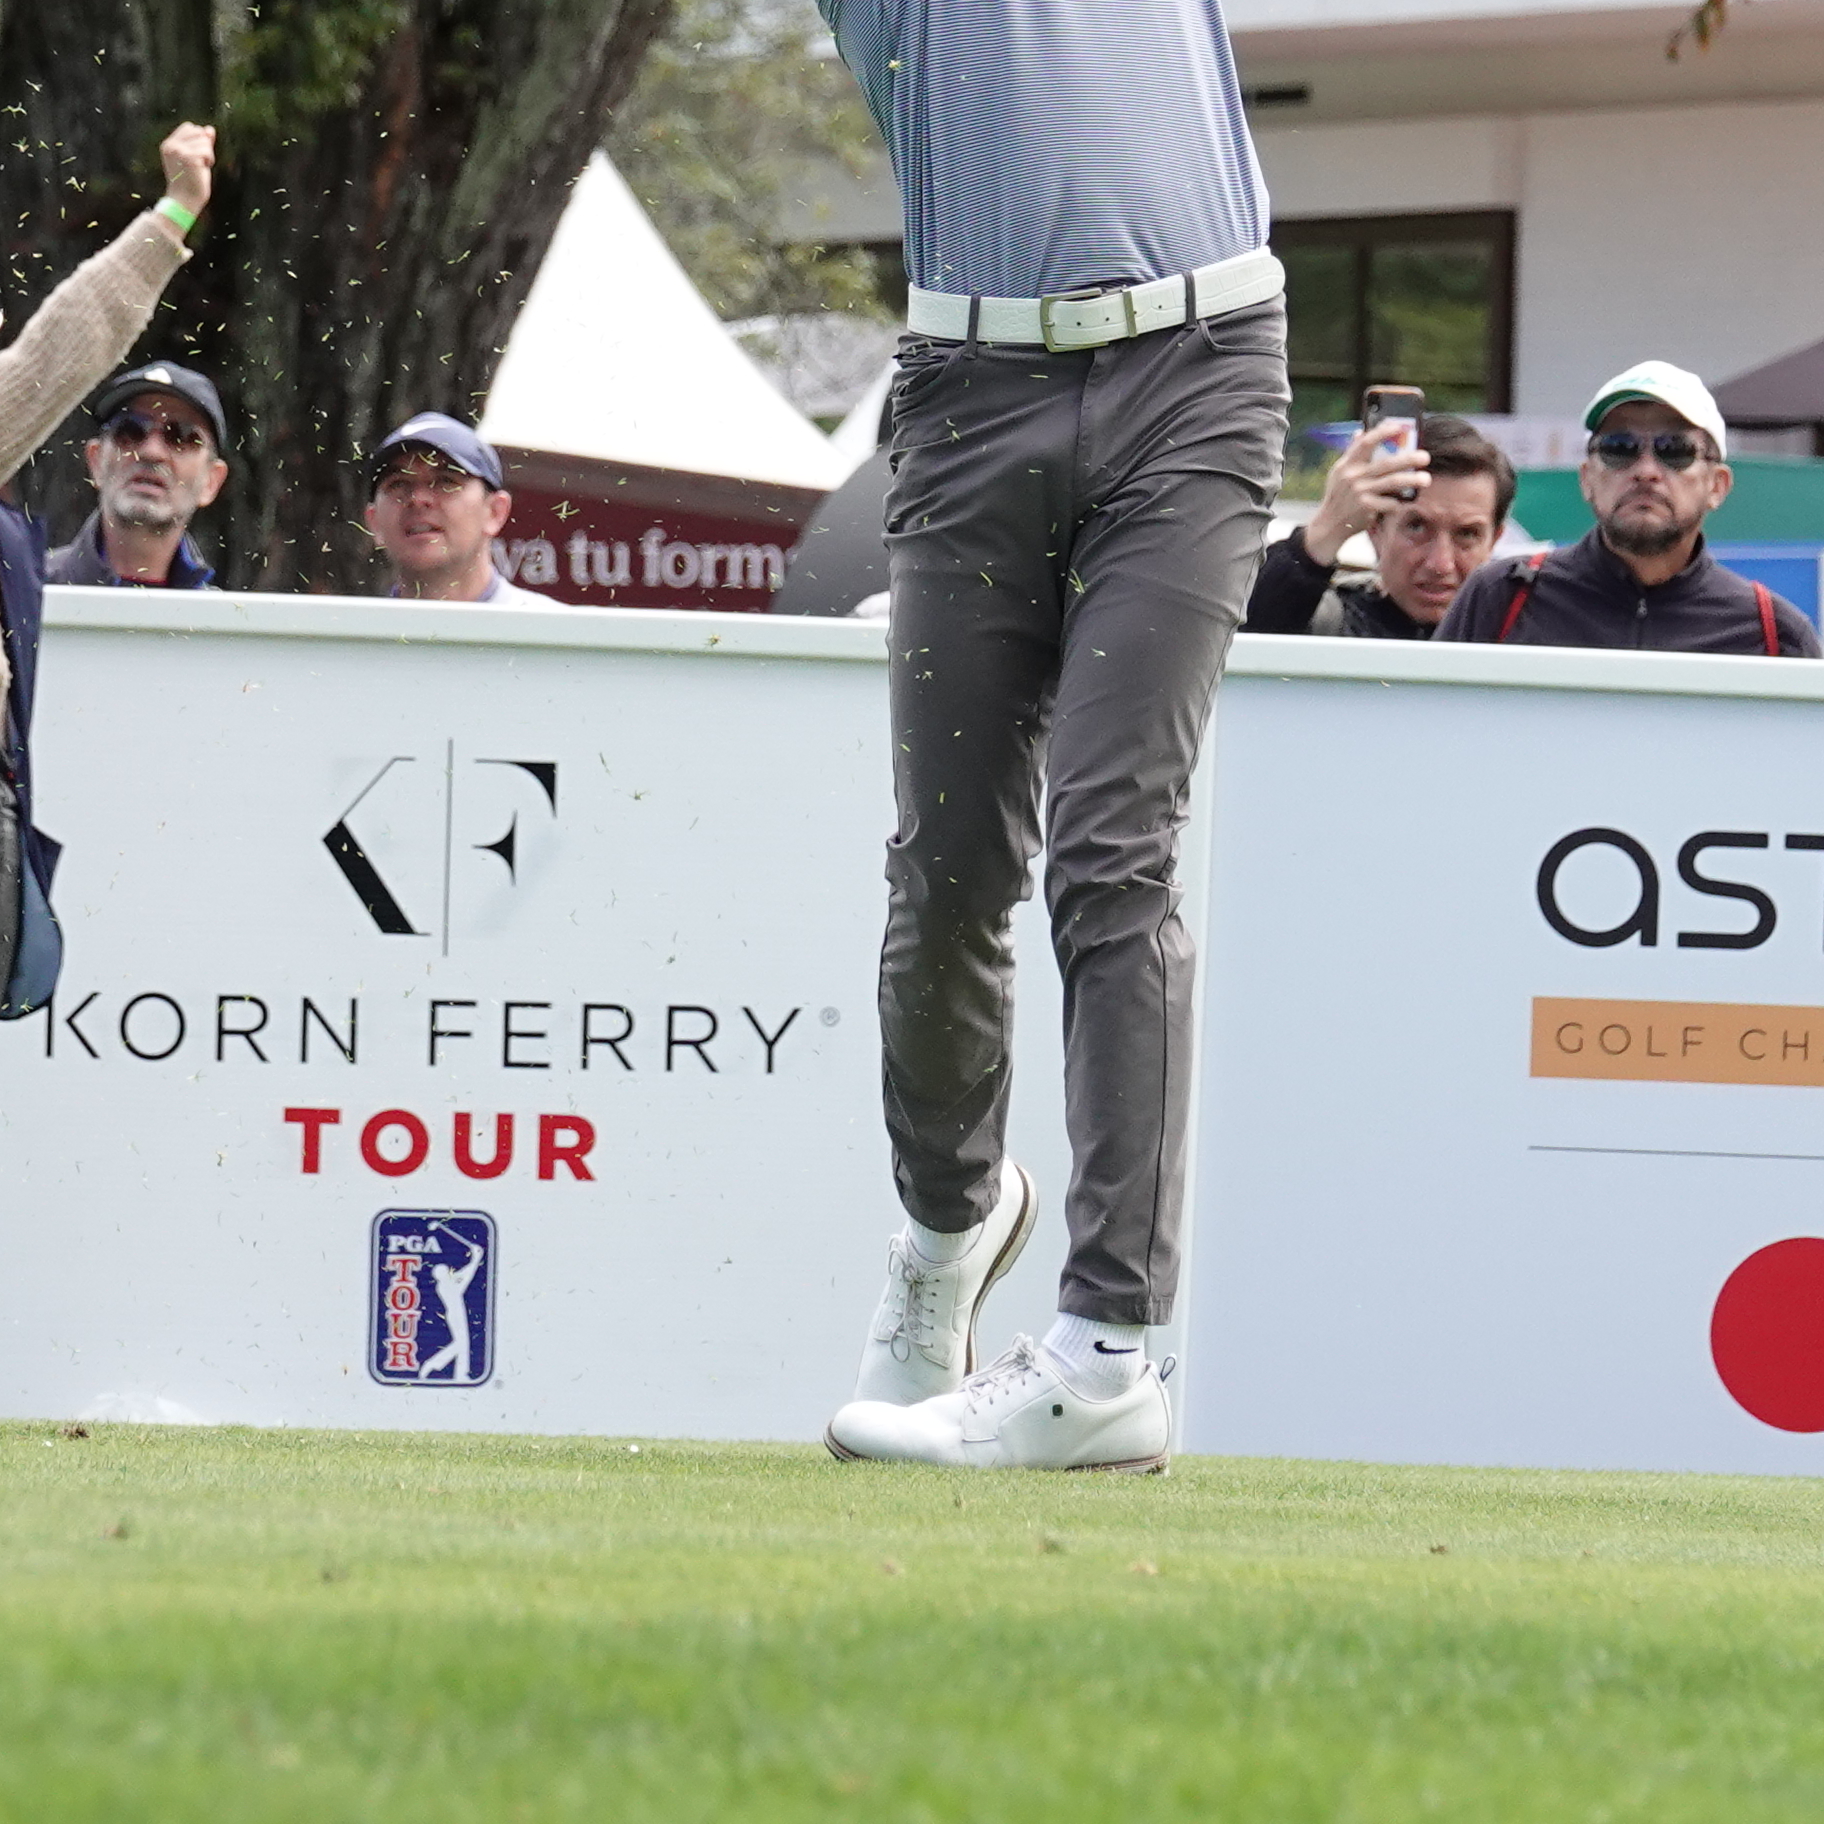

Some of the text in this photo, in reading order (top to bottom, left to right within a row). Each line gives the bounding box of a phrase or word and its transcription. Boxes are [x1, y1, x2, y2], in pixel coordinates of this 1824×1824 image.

[565, 528, 633, 588] tu
[640, 526, 798, 590] form
[44, 991, 803, 1076] KORN FERRY
[1554, 1021, 1706, 1058] GOLF
[283, 1106, 599, 1183] TOUR
[387, 1235, 443, 1254] PGA
[383, 1254, 422, 1373] TOUR
